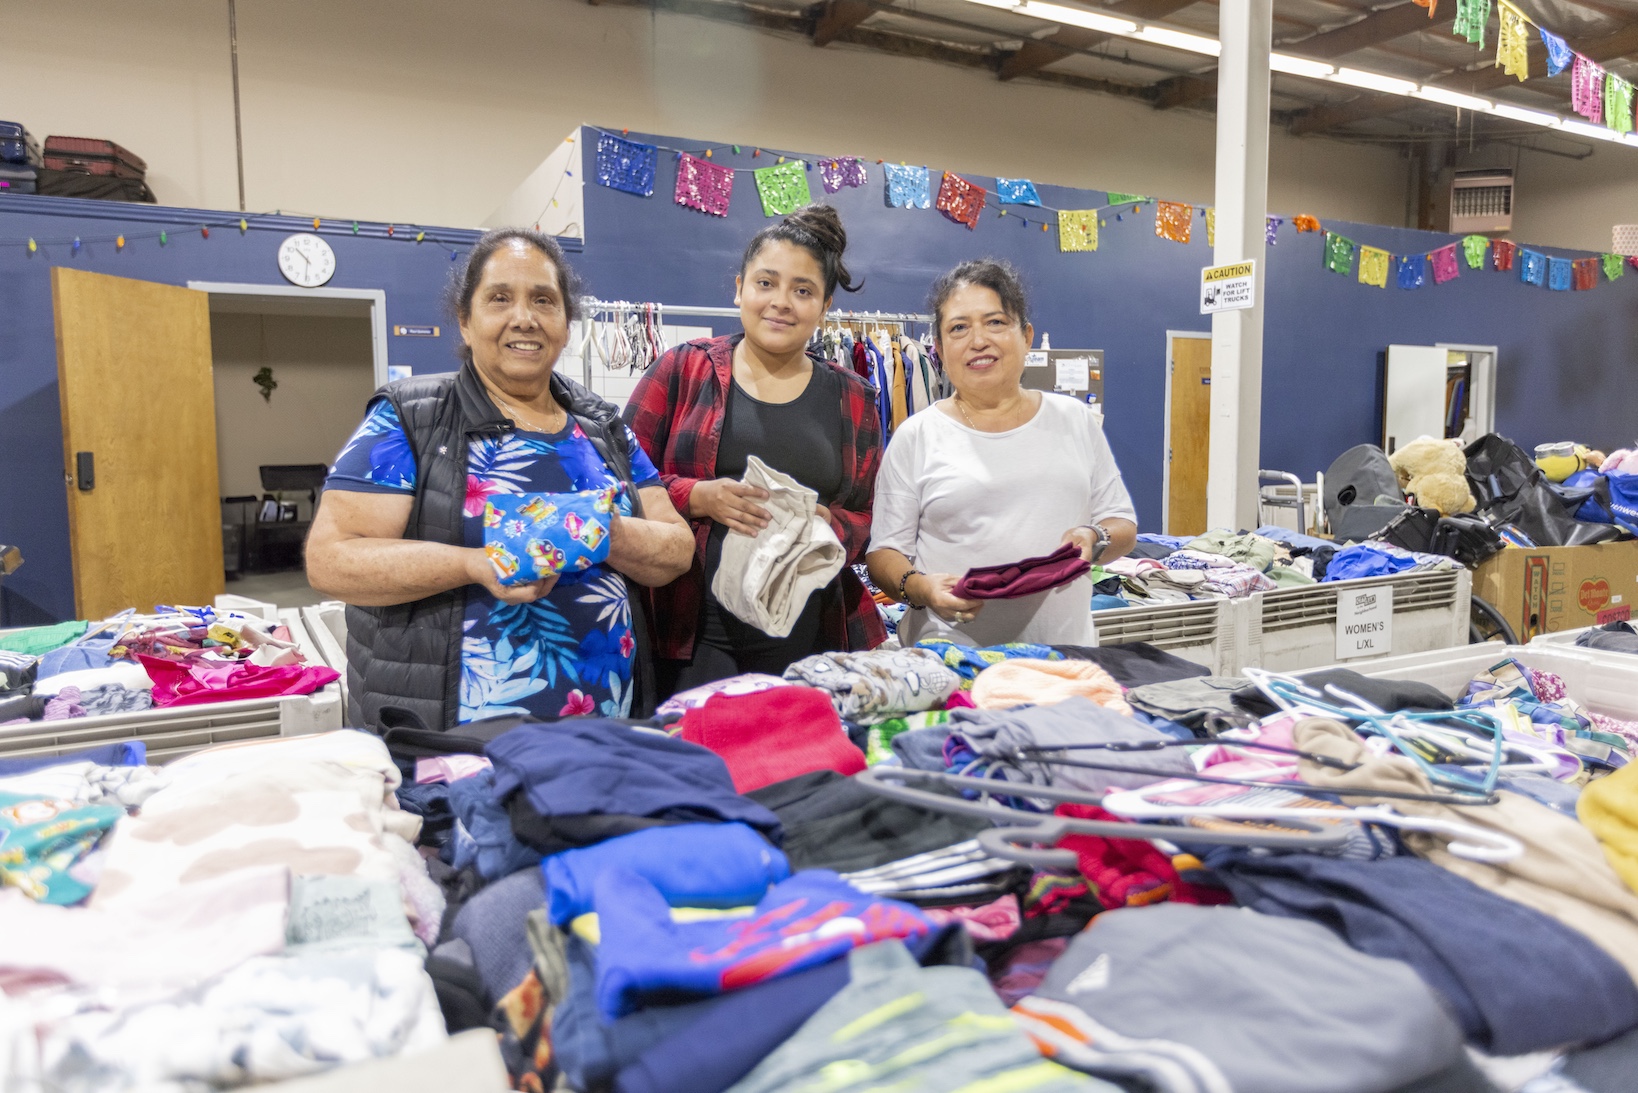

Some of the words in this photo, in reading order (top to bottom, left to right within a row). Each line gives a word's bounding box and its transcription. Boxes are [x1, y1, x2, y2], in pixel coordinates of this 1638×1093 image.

[1213, 265, 1251, 278] CAUTION
[1223, 295, 1249, 303] TRUCKS
[1532, 571, 1540, 608] WATCH
[1345, 621, 1384, 634] WOMEN'S
[1356, 639, 1374, 650] L/XL
